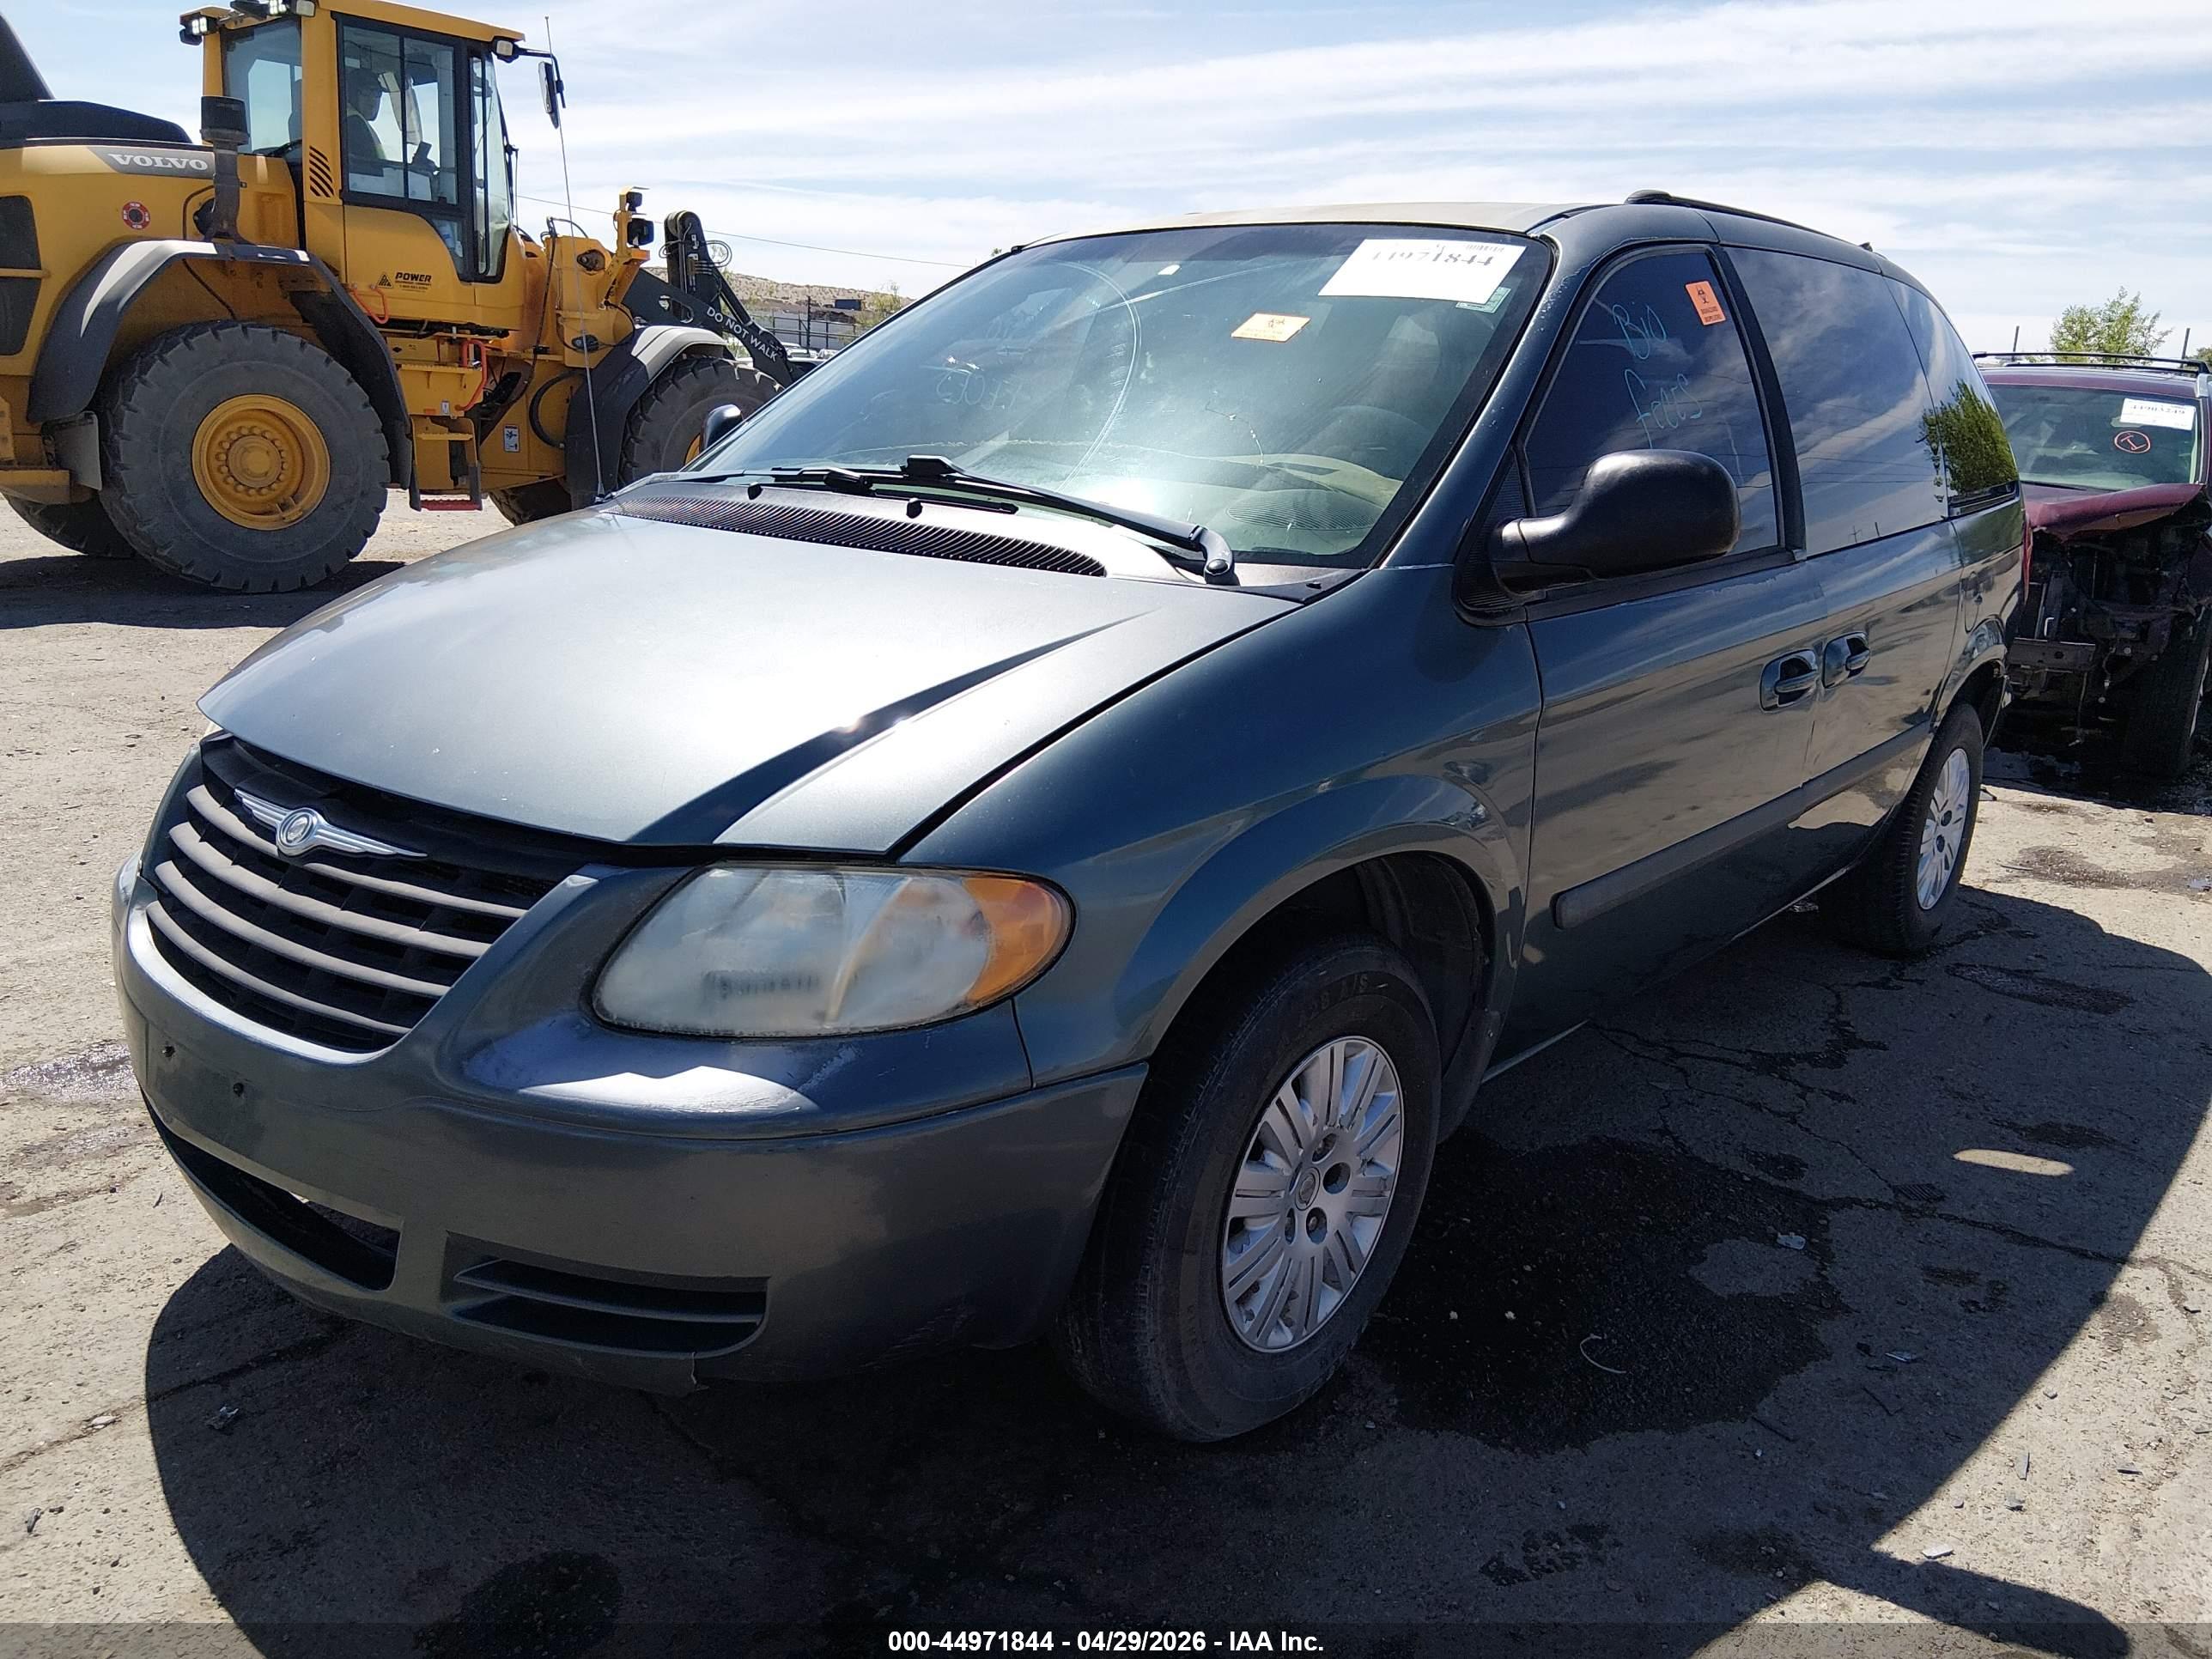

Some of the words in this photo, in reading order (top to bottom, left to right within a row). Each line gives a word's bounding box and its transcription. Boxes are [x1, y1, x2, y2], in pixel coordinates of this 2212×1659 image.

[108, 153, 209, 171] VOLVO
[395, 271, 432, 283] POWER
[706, 306, 724, 323] DO
[725, 318, 750, 338] NOT
[750, 334, 778, 362] WALK
